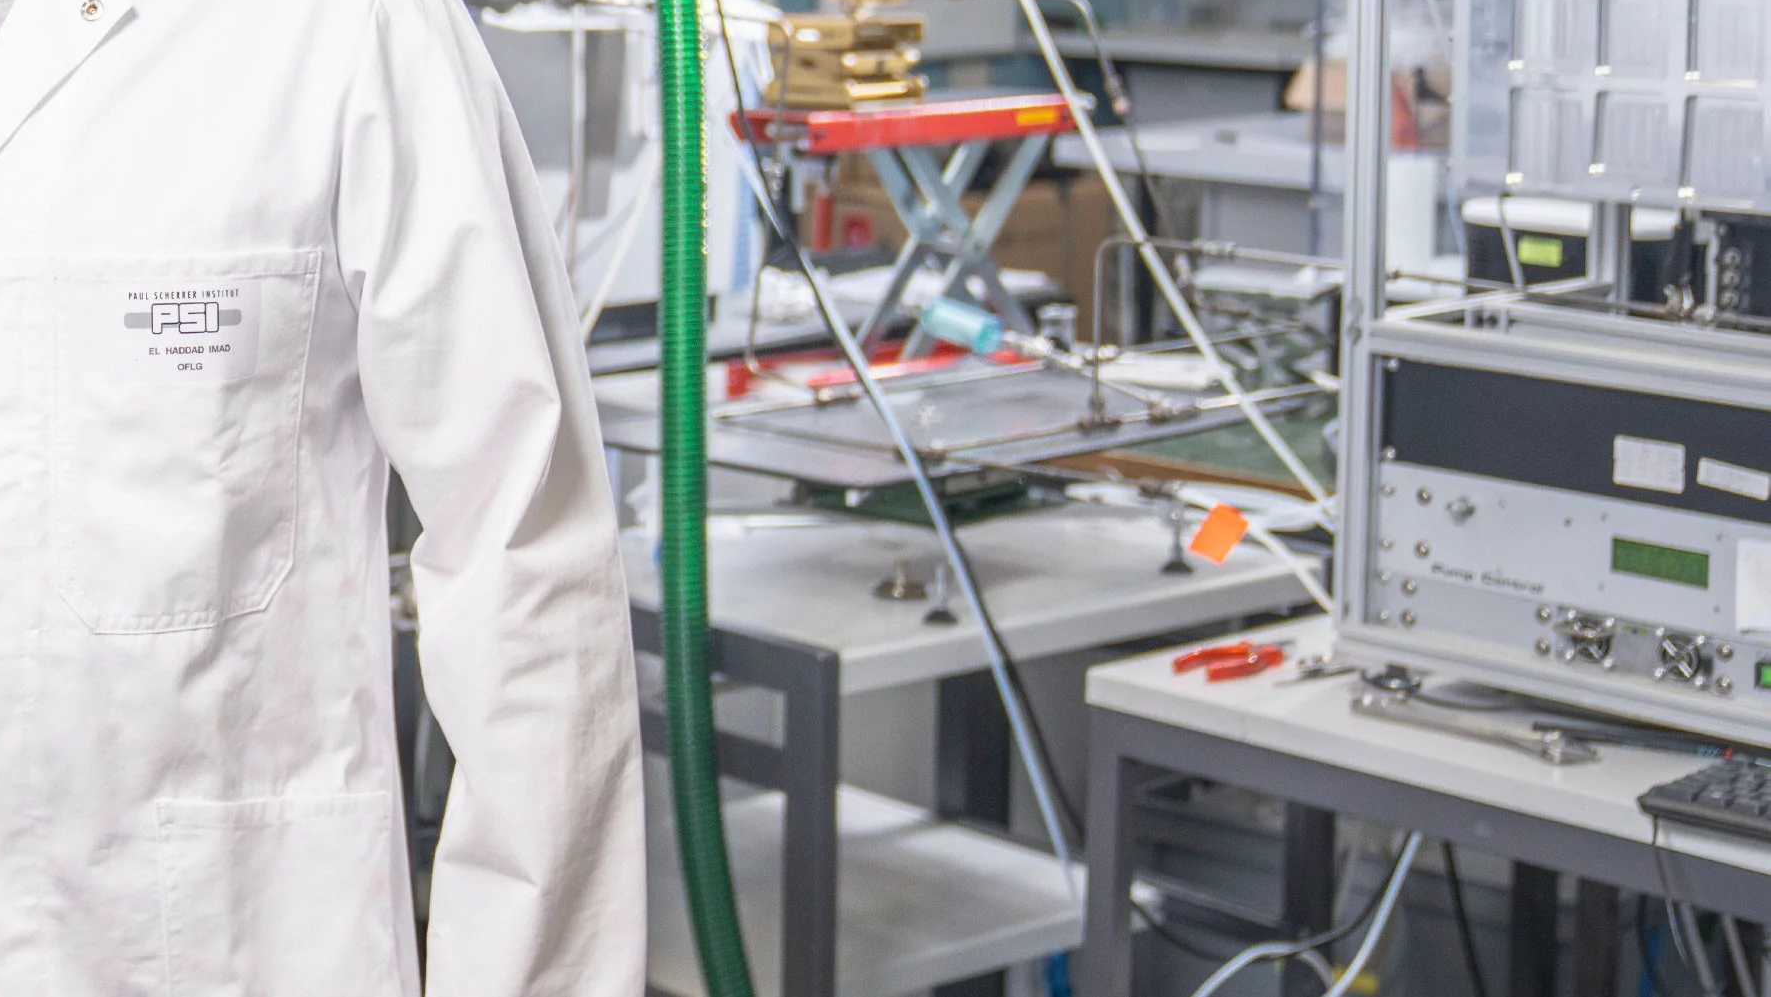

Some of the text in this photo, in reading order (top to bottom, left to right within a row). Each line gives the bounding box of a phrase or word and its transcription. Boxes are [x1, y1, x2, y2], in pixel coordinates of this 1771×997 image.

[128, 288, 239, 300] PAUL SCHERRER INSTITUT
[151, 301, 219, 335] PSI
[148, 344, 231, 355] EL HADDAD IMAD
[177, 362, 203, 371] OFLG
